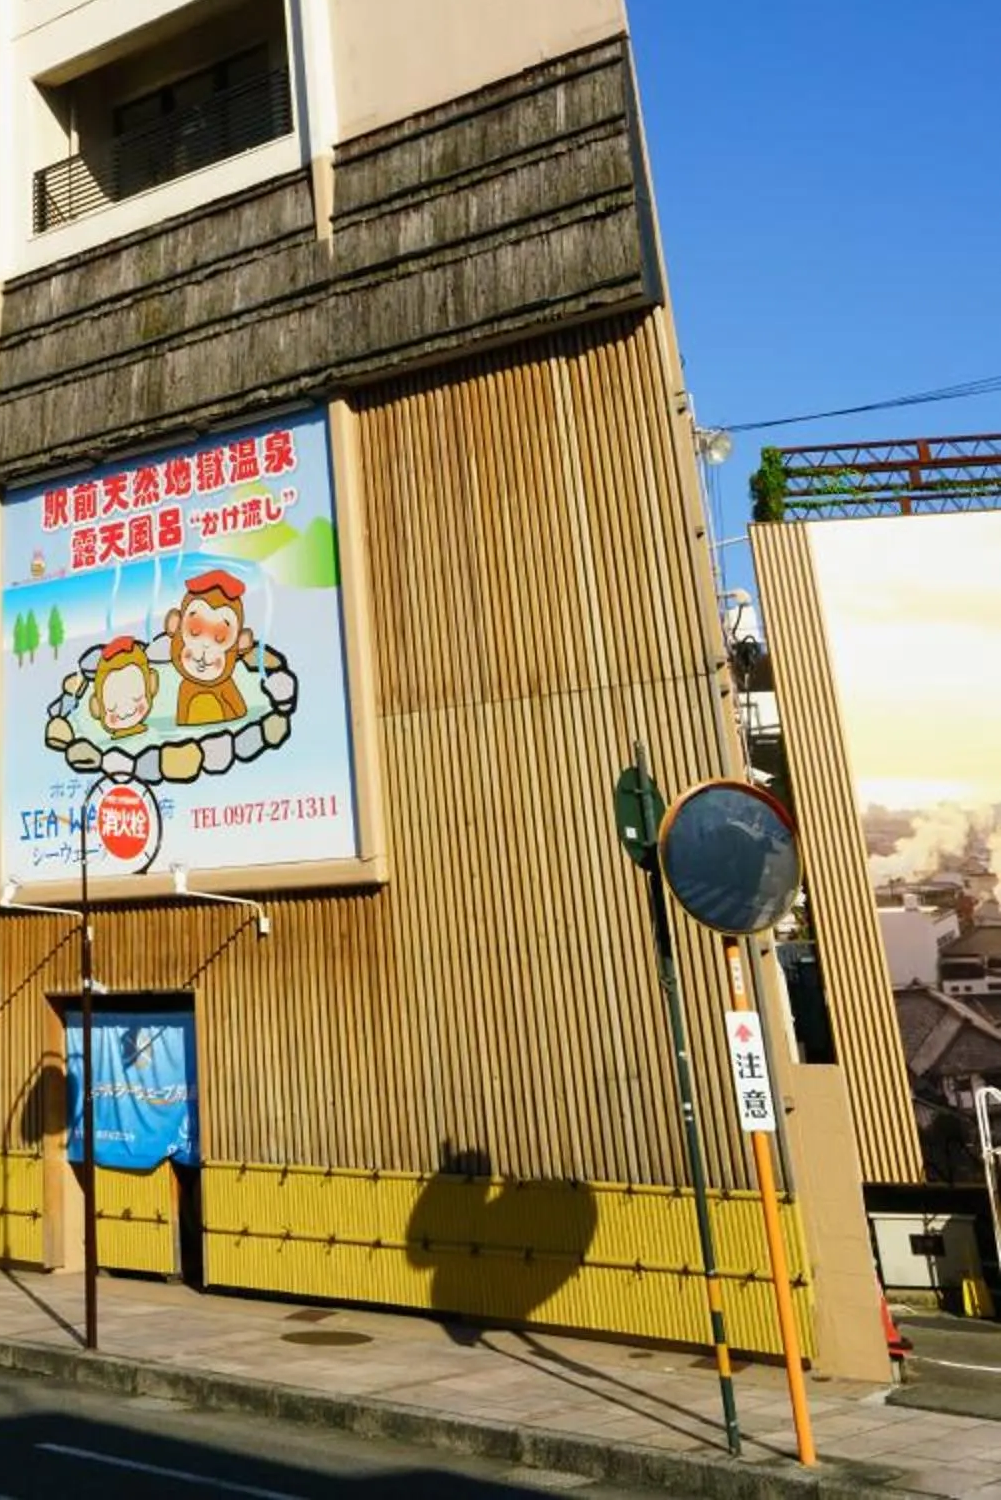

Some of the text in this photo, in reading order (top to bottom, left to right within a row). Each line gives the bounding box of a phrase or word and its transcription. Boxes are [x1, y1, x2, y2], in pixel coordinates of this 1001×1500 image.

[42, 429, 297, 529] 駅前天然地獄温泉
[72, 508, 182, 569] 露天風呂
[20, 808, 59, 840] SEA
[101, 807, 147, 838] 消火栓
[191, 794, 338, 830] TEL 0977-27-1311
[736, 1051, 768, 1119] 注意
